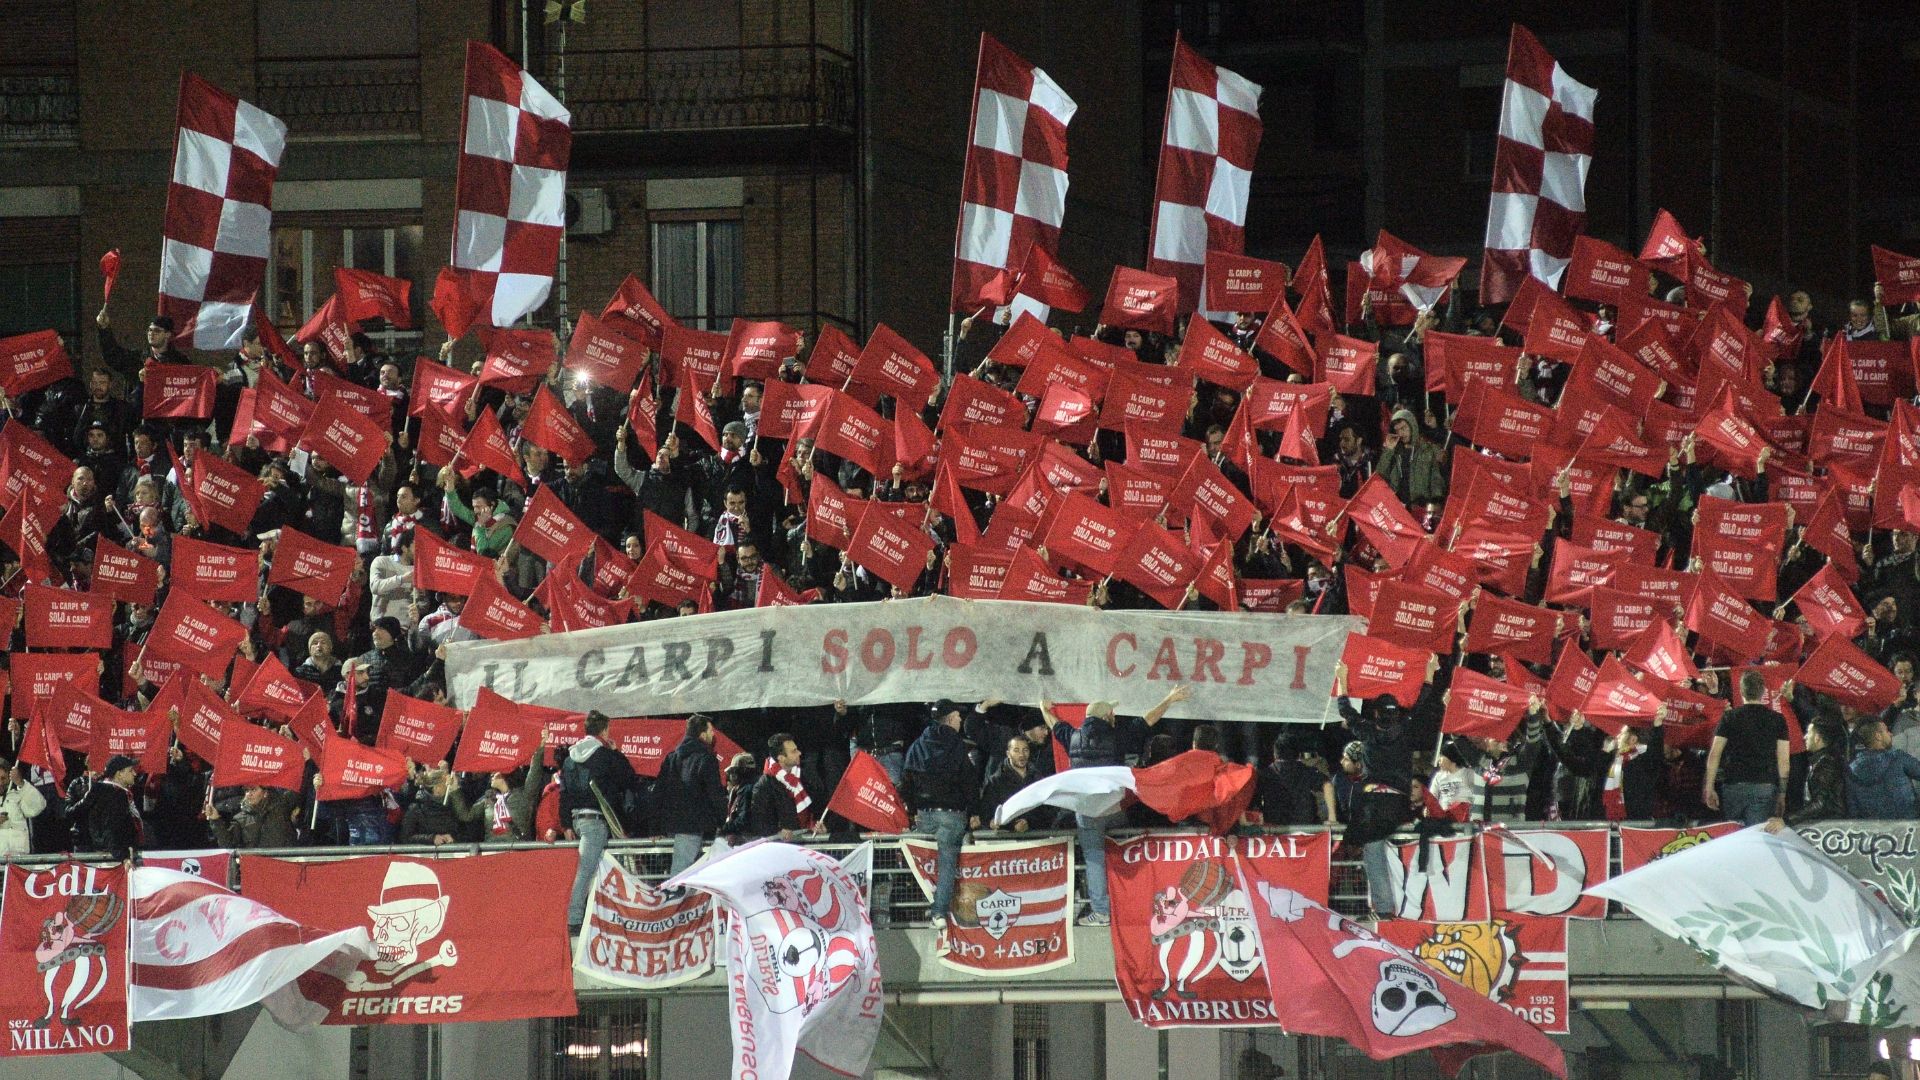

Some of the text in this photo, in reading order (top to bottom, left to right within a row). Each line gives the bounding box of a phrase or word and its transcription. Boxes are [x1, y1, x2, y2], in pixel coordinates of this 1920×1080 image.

[1228, 269, 1235, 277] IL
[1226, 279, 1240, 290] SOLO
[1210, 338, 1234, 352] IL CARPI
[1204, 346, 1219, 360] SOLO
[1223, 357, 1240, 369] CARPI
[1150, 440, 1169, 448] CARPI
[1140, 448, 1156, 460] SOLO
[1161, 454, 1180, 462] CARPI
[543, 508, 566, 527] IL CARPI
[535, 516, 569, 544] SOLO A CARPI
[1081, 517, 1106, 534] IL CARPI
[878, 526, 901, 545] IL CARPI
[1073, 525, 1090, 540] SOLO
[1093, 537, 1111, 550] CARPI
[870, 534, 886, 550] SOLO
[887, 548, 904, 563] CARPI
[1714, 551, 1742, 560] IL CARPI
[110, 556, 128, 565] CARPI
[199, 555, 225, 564] IL CARPI
[1151, 547, 1174, 567] IL CARPI
[99, 565, 114, 577] SOLO
[120, 571, 138, 581] CARPI
[196, 566, 212, 577] SOLO
[219, 570, 237, 578] CARPI
[1141, 554, 1158, 570] SOLO
[1159, 569, 1176, 584] CARPI
[1712, 561, 1754, 575] SOLO A CARPI
[52, 602, 79, 610] IL CARPI
[1400, 601, 1426, 613] IL CARPI
[49, 612, 65, 622] SOLO
[183, 616, 208, 632] IL CARPI
[1395, 611, 1435, 628] SOLO A CARPI
[175, 624, 213, 650] SOLO A CARPI
[484, 626, 1312, 699] IL CARPI SOLO A CARPI
[1368, 655, 1395, 667] IL CARPI
[1361, 664, 1379, 676] SOLO
[1384, 671, 1404, 680] CARPI
[399, 715, 425, 728] IL CARPI
[394, 725, 411, 736] SOLO
[416, 732, 433, 743] CARPI
[484, 730, 510, 743] IL CARPI
[632, 736, 650, 744] CARPI
[246, 744, 273, 754] IL CARPI
[479, 740, 496, 754] SOLO
[500, 748, 519, 756] CARPI
[621, 745, 637, 754] SOLO
[643, 748, 662, 756] CARPI
[241, 754, 283, 770] SOLO A CARPI
[347, 760, 373, 772] IL CARPI
[342, 770, 359, 782] SOLO
[364, 777, 384, 786] CARPI
[1247, 837, 1306, 859] DAL
[24, 865, 109, 899] GdL
[981, 898, 1017, 909] CARPI
[624, 918, 675, 933] GIUGNO
[342, 995, 462, 1016] FIGHTERS
[1530, 996, 1555, 1005] 1992
[9, 1019, 33, 1029] sez.
[10, 1024, 114, 1051] MILANO
